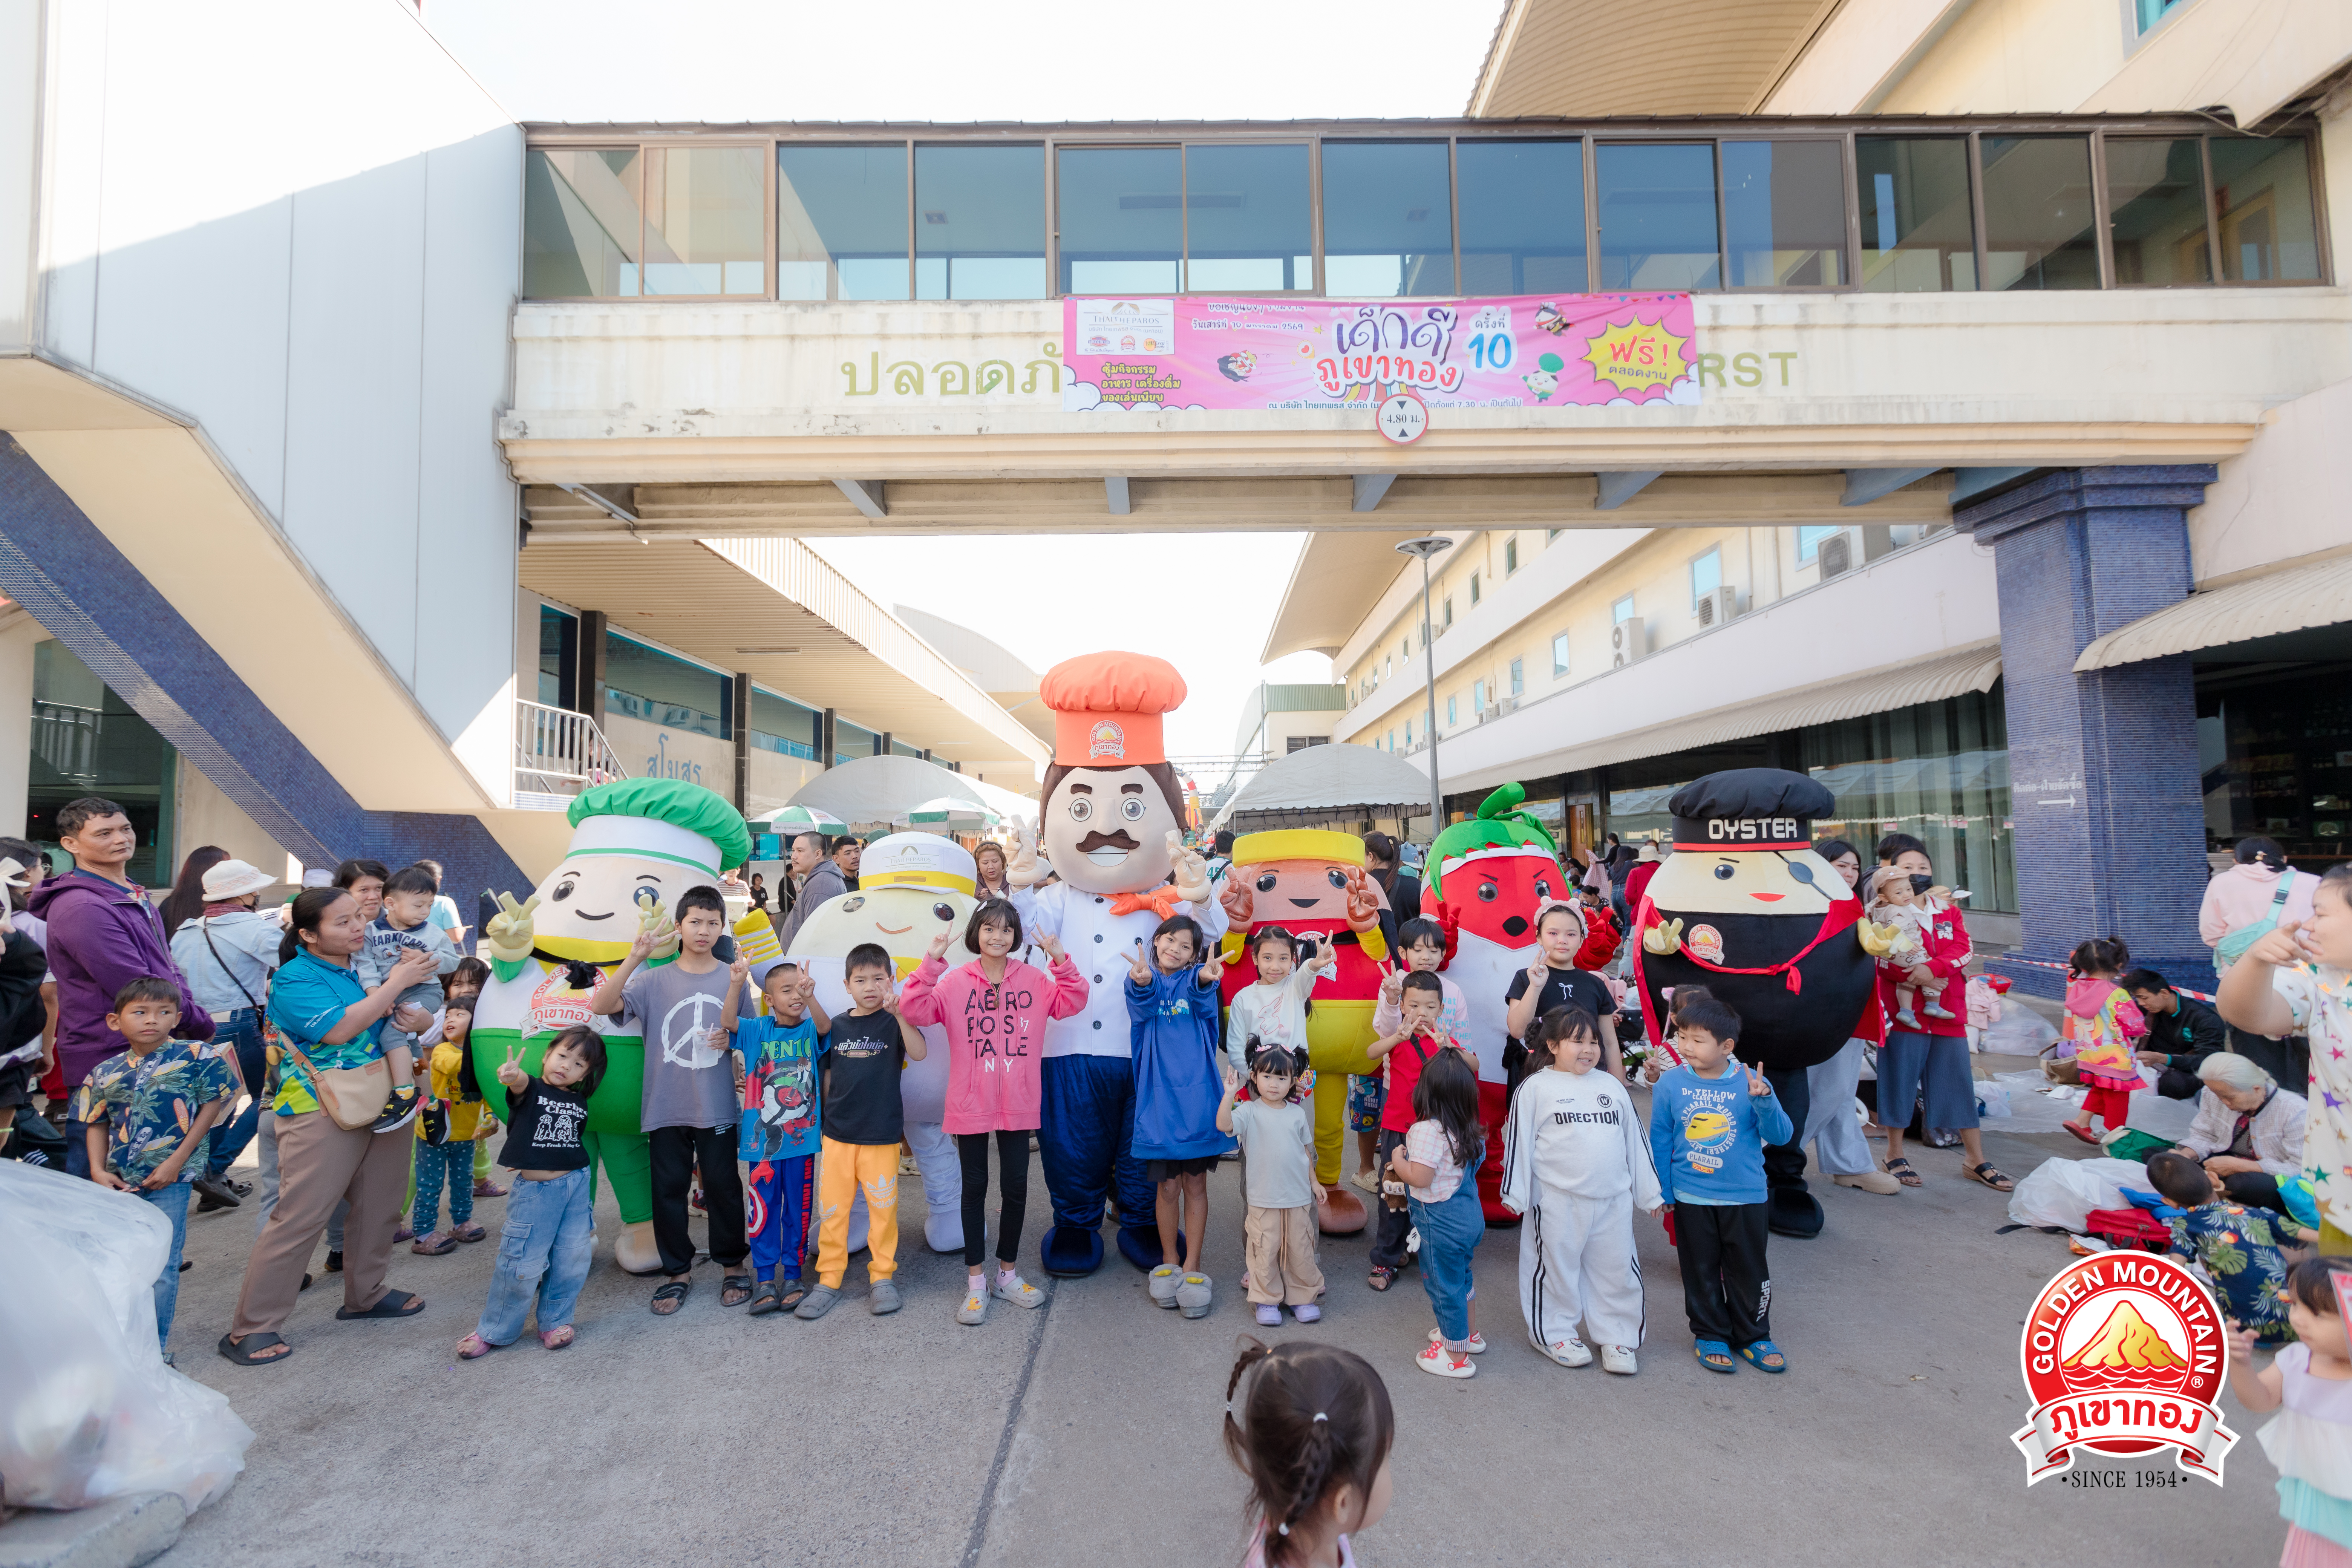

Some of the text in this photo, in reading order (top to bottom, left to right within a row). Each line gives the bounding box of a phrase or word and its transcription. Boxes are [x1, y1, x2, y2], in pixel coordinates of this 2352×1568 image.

[1093, 315, 1159, 324] THAITHEPAROS
[1475, 311, 1506, 329] ครั้งที่
[1337, 306, 1451, 357] เด็กดี
[1468, 333, 1512, 369] 10
[841, 341, 1063, 396] ปลอดภั
[1101, 362, 1156, 378] ซุ้มกิจกรรม
[1317, 355, 1457, 392] ภูเขาทอง
[1609, 366, 1668, 380] ตลอดงาน
[1697, 352, 1798, 387] RST
[1101, 374, 1180, 389] อาหาร เครื่องดื่ม
[1101, 391, 1164, 402] ของเล่นเพียบ
[1304, 400, 1344, 409] ไทยเทพรส
[1424, 399, 1455, 407] ปิดตั้งแต่
[1386, 413, 1420, 424] 4.80 ม.
[1092, 722, 1122, 741] GOLDEN MOUNTAIN
[1709, 817, 1797, 839] OYSTER
[1690, 926, 1720, 946] GOLDEN MOUNTAIN
[534, 966, 571, 1000] GOLDEN
[534, 1009, 592, 1023] ภูเขาทอง
[838, 1036, 885, 1050] แล้วยังไงต่อ
[1683, 1100, 1712, 1115] PLARAIL
[1717, 1103, 1737, 1125] WORLD
[1553, 1110, 1620, 1126] DIRECTION
[1707, 1128, 1737, 1155] TOGETHER!
[1689, 1153, 1719, 1166] PLARAIL
[1693, 1162, 1712, 1173] プラレール
[870, 1195, 896, 1208] adidas
